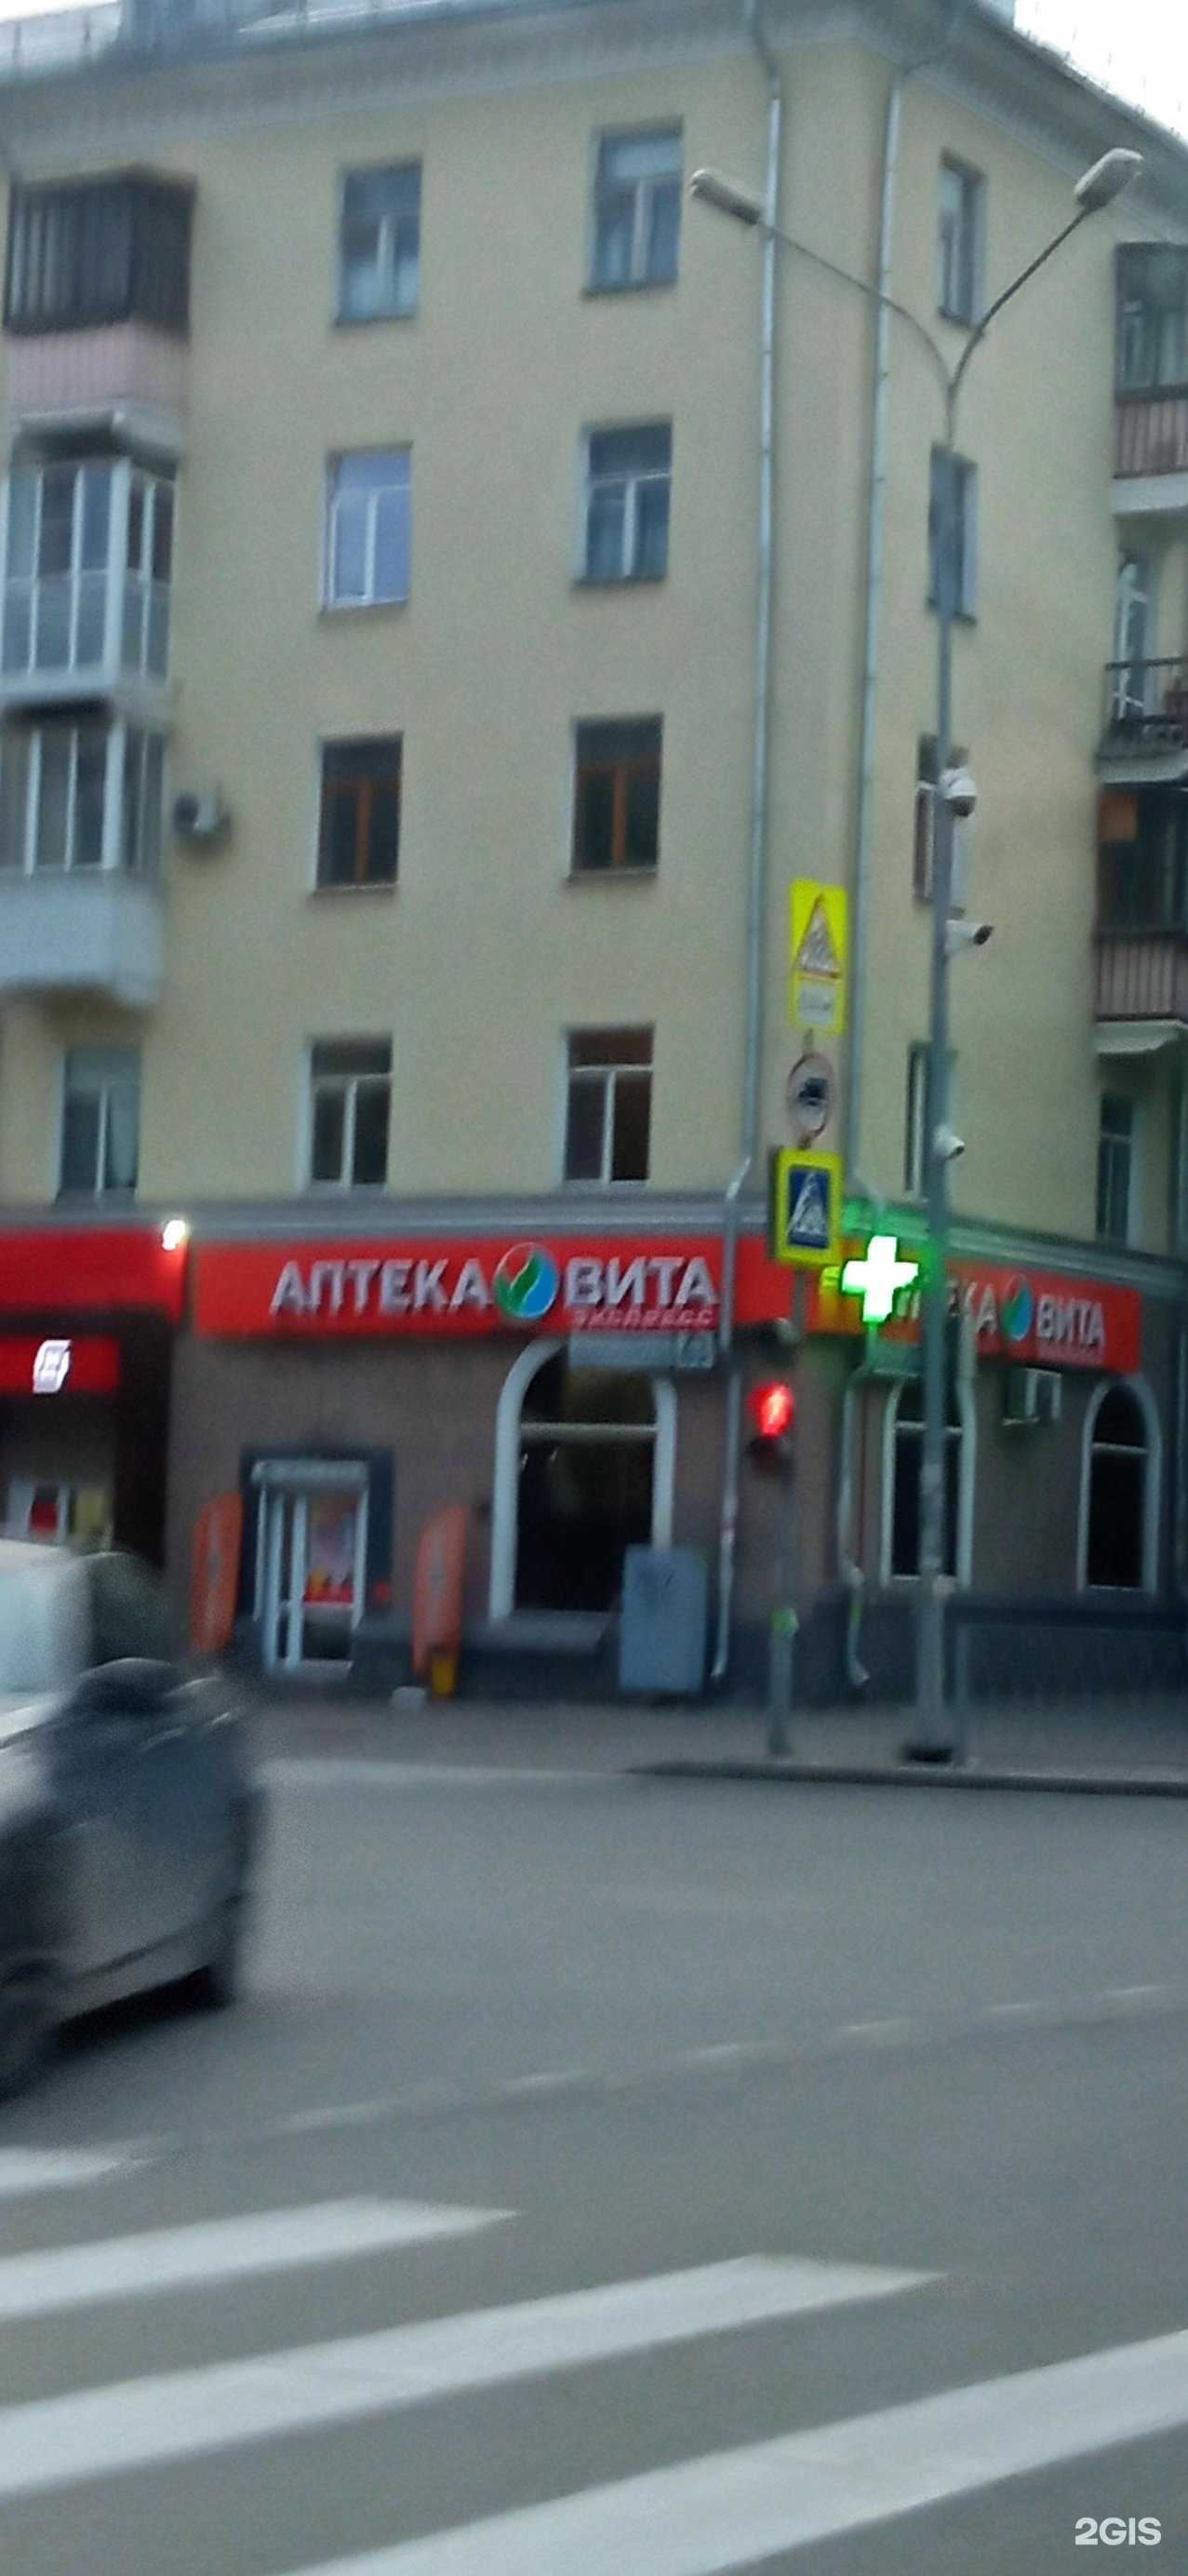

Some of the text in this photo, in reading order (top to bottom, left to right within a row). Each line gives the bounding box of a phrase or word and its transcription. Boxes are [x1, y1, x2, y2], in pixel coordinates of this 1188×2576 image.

[271, 1256, 718, 1314] АПТЕКА ВИТА
[1036, 1294, 1104, 1348] ВИТА
